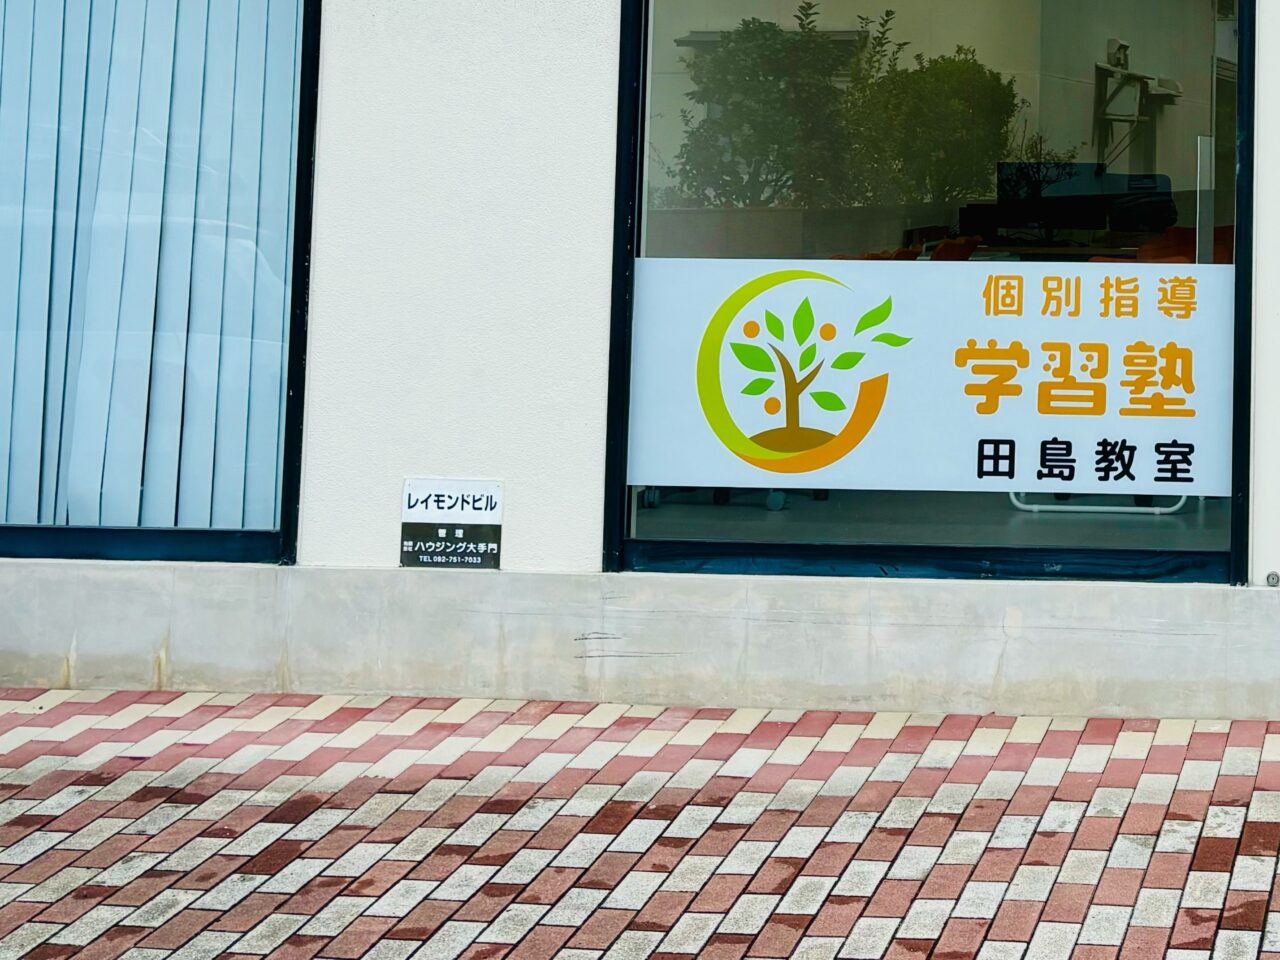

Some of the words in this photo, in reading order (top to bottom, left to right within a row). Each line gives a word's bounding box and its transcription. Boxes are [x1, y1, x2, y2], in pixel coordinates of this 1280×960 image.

[982, 274, 1199, 319] 個別指導
[954, 338, 1198, 418] 学習塾
[976, 437, 1195, 484] 田島教室
[407, 493, 498, 511] レイモンドビル
[418, 555, 432, 563] TEL
